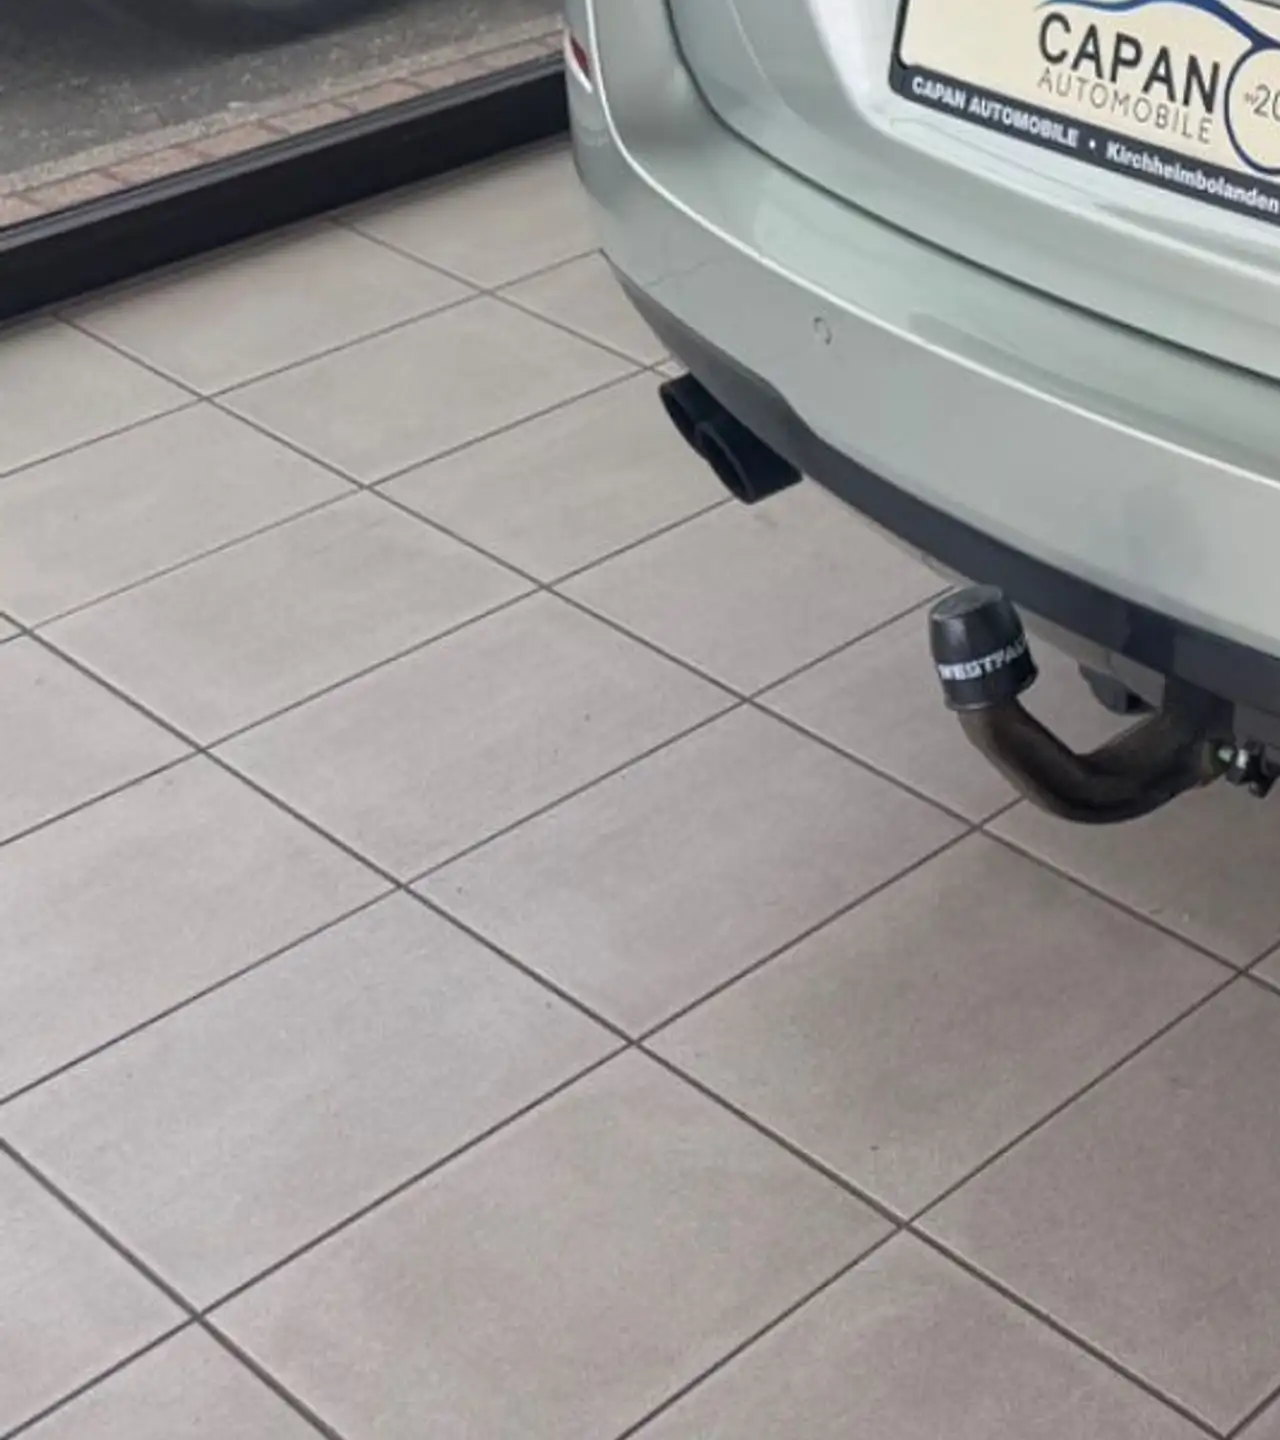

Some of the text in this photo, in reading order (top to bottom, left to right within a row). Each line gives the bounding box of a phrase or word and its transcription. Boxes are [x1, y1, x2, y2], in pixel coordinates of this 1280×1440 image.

[1037, 66, 1214, 144] AUTOMOBILE
[1038, 12, 1220, 115] CAPAN
[912, 76, 967, 110] CAPAN
[968, 93, 1080, 149] AUTOMOBILE
[1105, 140, 1280, 215] Kirchheimbolanden
